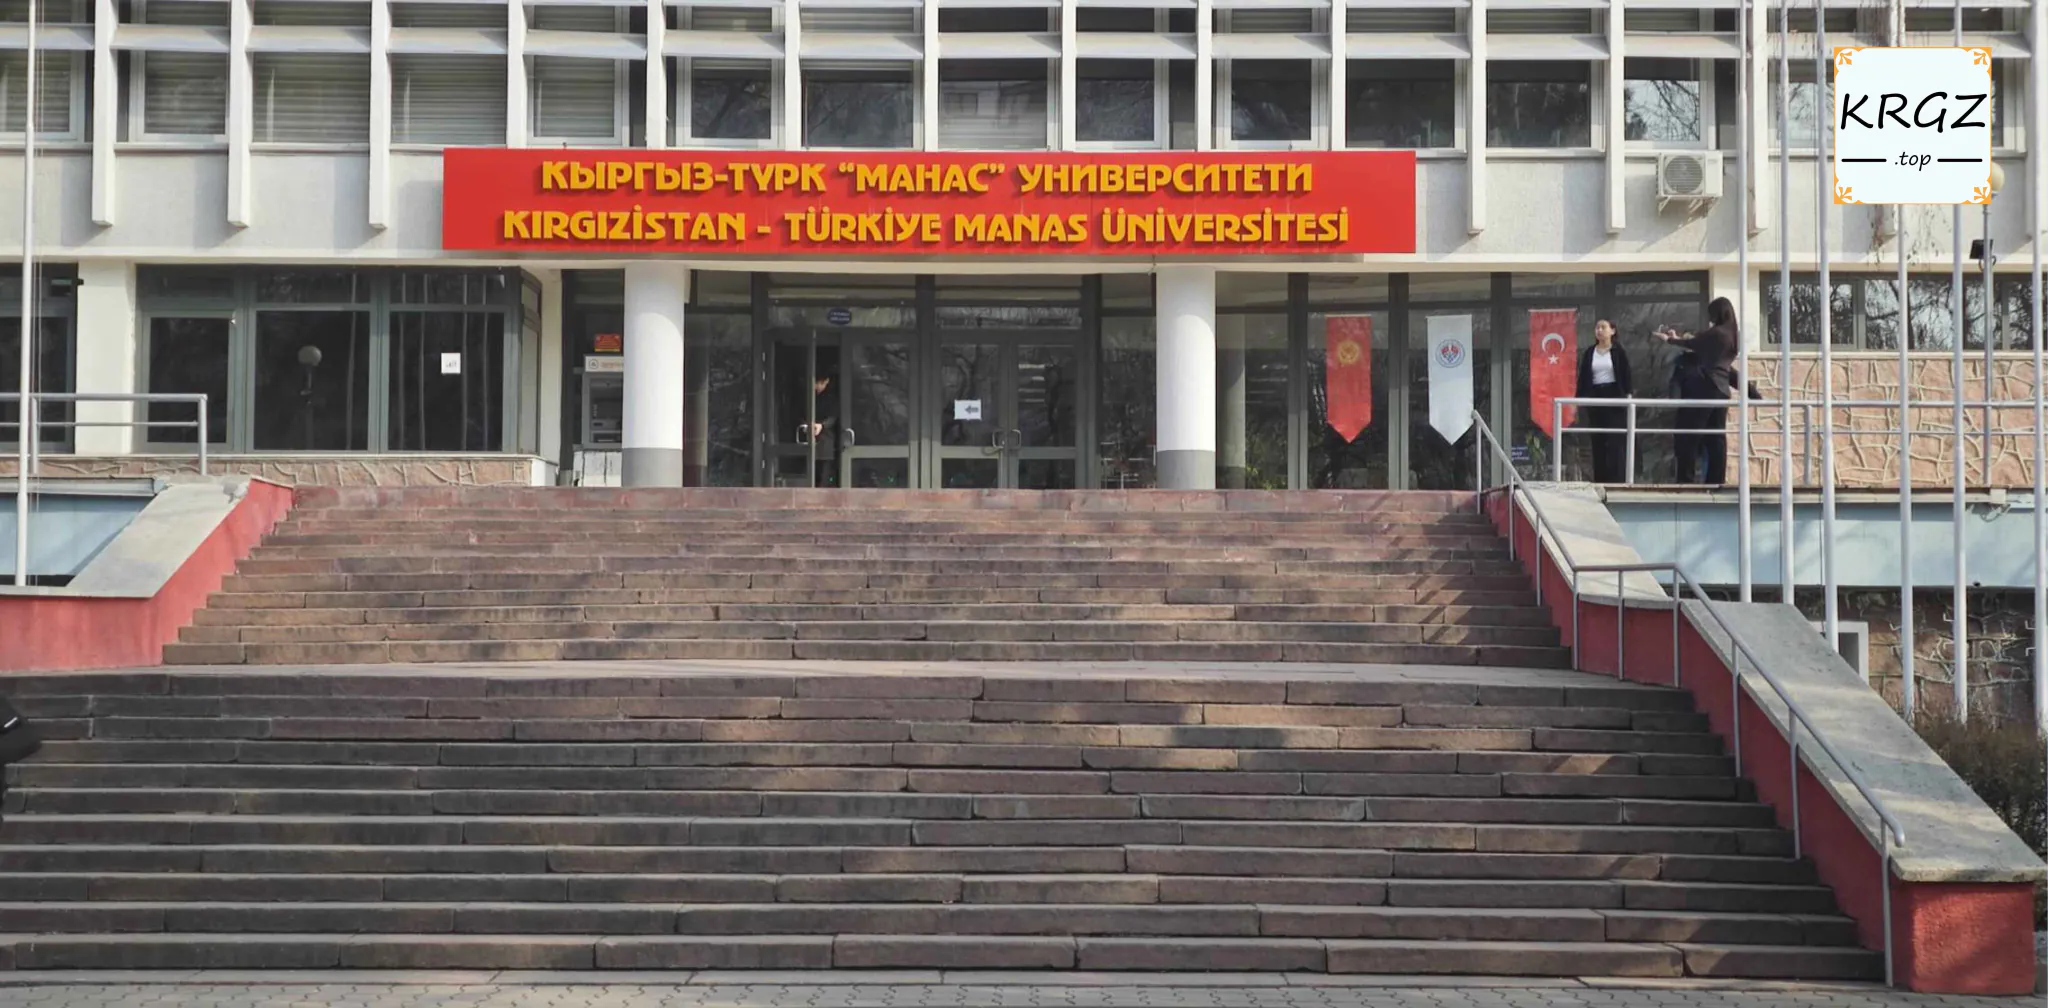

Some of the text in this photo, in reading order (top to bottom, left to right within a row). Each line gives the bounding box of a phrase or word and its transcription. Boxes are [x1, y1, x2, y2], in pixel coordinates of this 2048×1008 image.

[1017, 163, 1313, 193] УНИВЕРСИТЕТИ
[503, 204, 746, 242] KIRGIZİSTAN
[784, 206, 941, 242] TÜRKİYE
[953, 213, 1088, 243] MANAS
[1102, 208, 1349, 243] ÜNİVERSİTESİ
